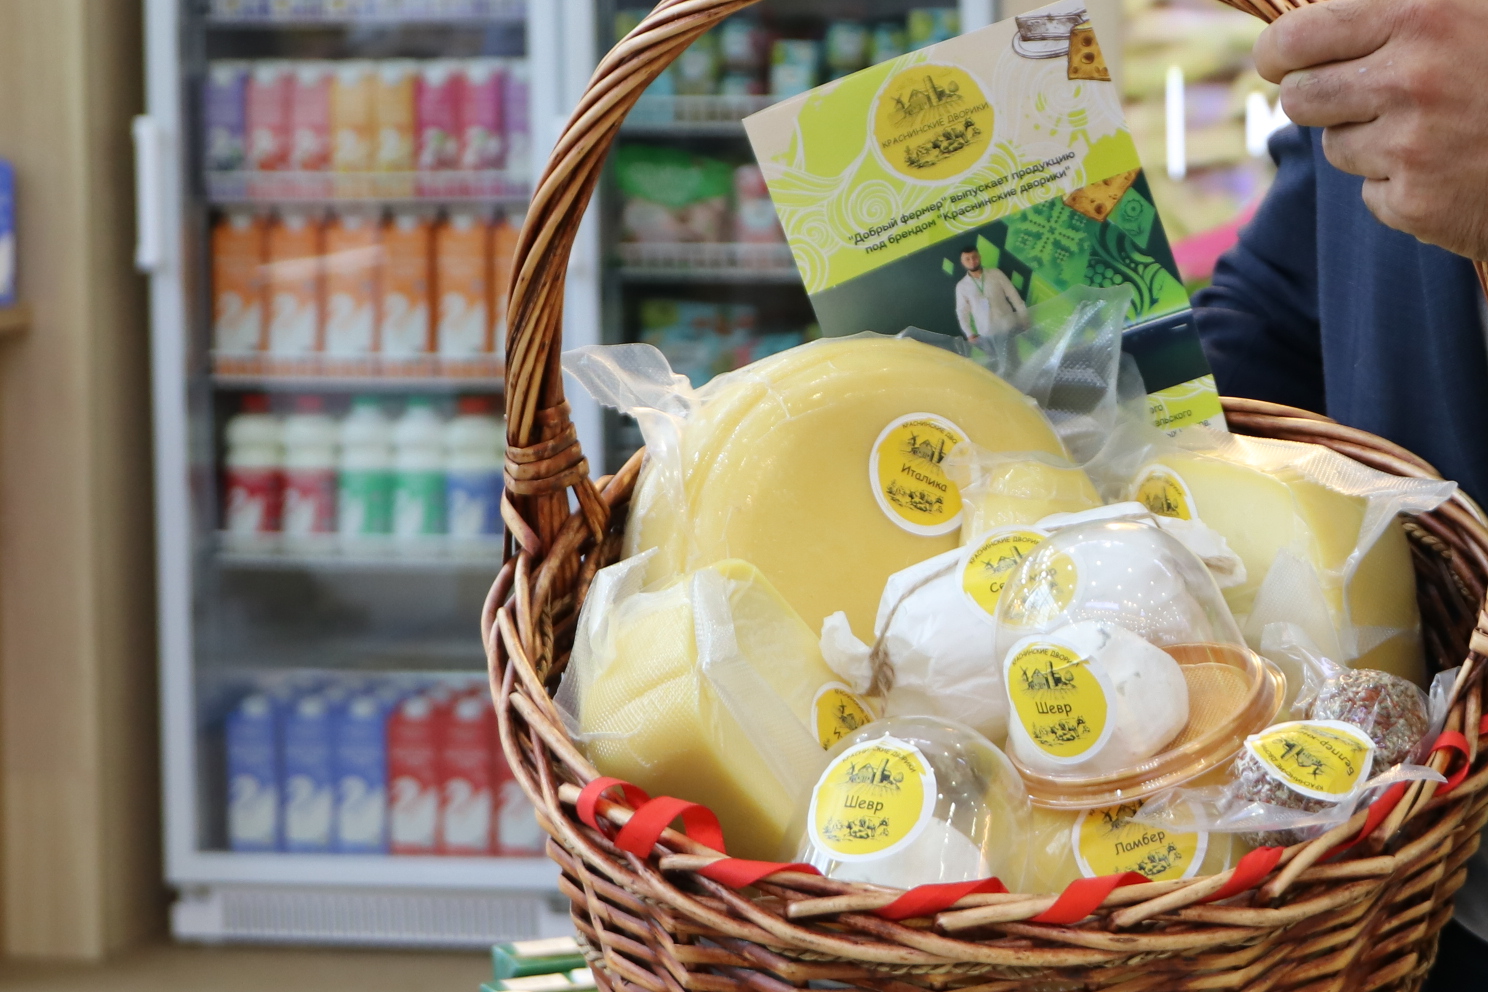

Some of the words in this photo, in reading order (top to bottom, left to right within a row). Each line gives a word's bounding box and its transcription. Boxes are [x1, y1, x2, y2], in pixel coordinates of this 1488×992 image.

[881, 116, 946, 150] КРАСНИНСКИЕ
[946, 101, 991, 124] ДВОРИКИ
[949, 174, 1009, 204] выпускает
[1011, 150, 1076, 181] продукцию
[865, 240, 888, 255] под
[887, 218, 937, 244] брендом
[900, 463, 948, 493] Италика
[1034, 701, 1072, 716] Шевр
[844, 794, 884, 815] Шевр
[1114, 830, 1166, 856] Ламбер
